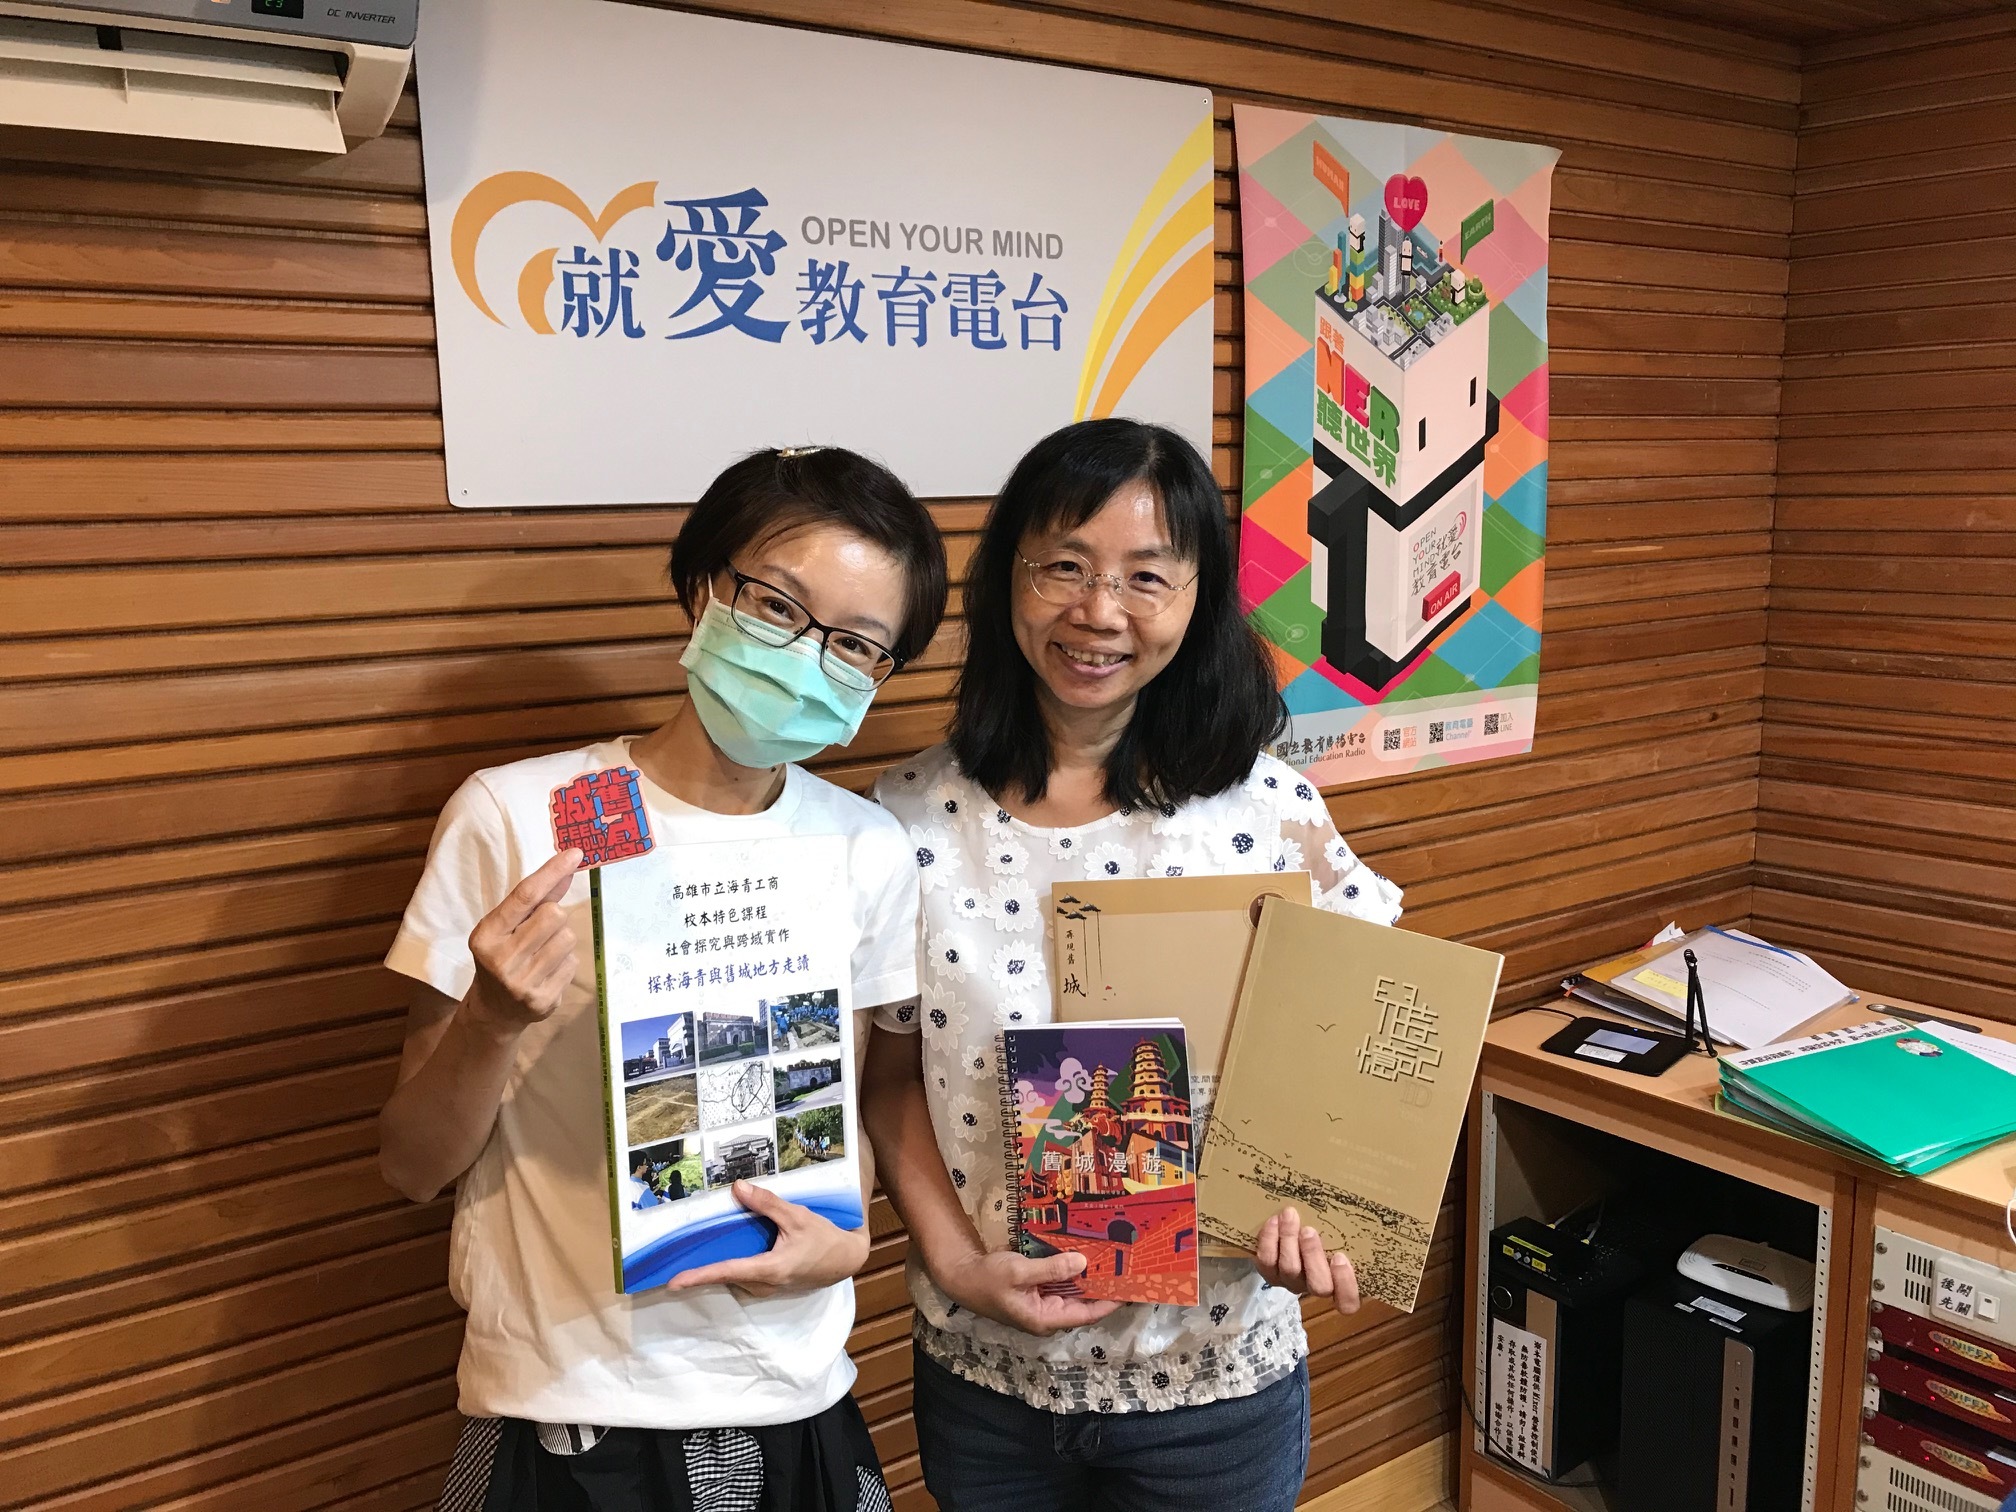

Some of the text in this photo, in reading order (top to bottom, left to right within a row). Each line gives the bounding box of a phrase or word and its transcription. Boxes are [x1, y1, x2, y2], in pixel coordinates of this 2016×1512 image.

[327, 8, 396, 24] DC INVERTER
[1393, 197, 1420, 211] LOVE
[801, 215, 1064, 260] OPEN YOUR MIND
[1464, 212, 1491, 240] EARTH
[1320, 316, 1344, 355] 跟著
[1316, 336, 1400, 454] NER
[1317, 388, 1396, 488] 聽世界
[1413, 527, 1437, 552] OPEN
[1413, 540, 1436, 564] YOUR
[1413, 553, 1435, 578] MIND
[1430, 583, 1458, 615] ON AIR
[1500, 712, 1513, 723] 加入
[1500, 723, 1512, 733] LINE
[1403, 726, 1417, 737] 官方
[1403, 737, 1417, 748] 網站
[1286, 748, 1366, 766] tional Education Radio
[557, 819, 602, 843] FEEL
[672, 876, 779, 900] 高雄市立海青工商
[684, 905, 768, 928] 校本特色課程
[666, 928, 790, 957] 社會探究與跨域實作
[648, 954, 810, 994] 探索海青與舊城地方走讀
[1042, 1149, 1162, 1175] 舊城漫遊
[1940, 1277, 1973, 1298] 後開
[1939, 1296, 1972, 1316] 先關
[1932, 1331, 1994, 1361] SONIFEX
[1928, 1381, 1990, 1411] SONIFEX
[1925, 1443, 1983, 1474] SONIFEX
